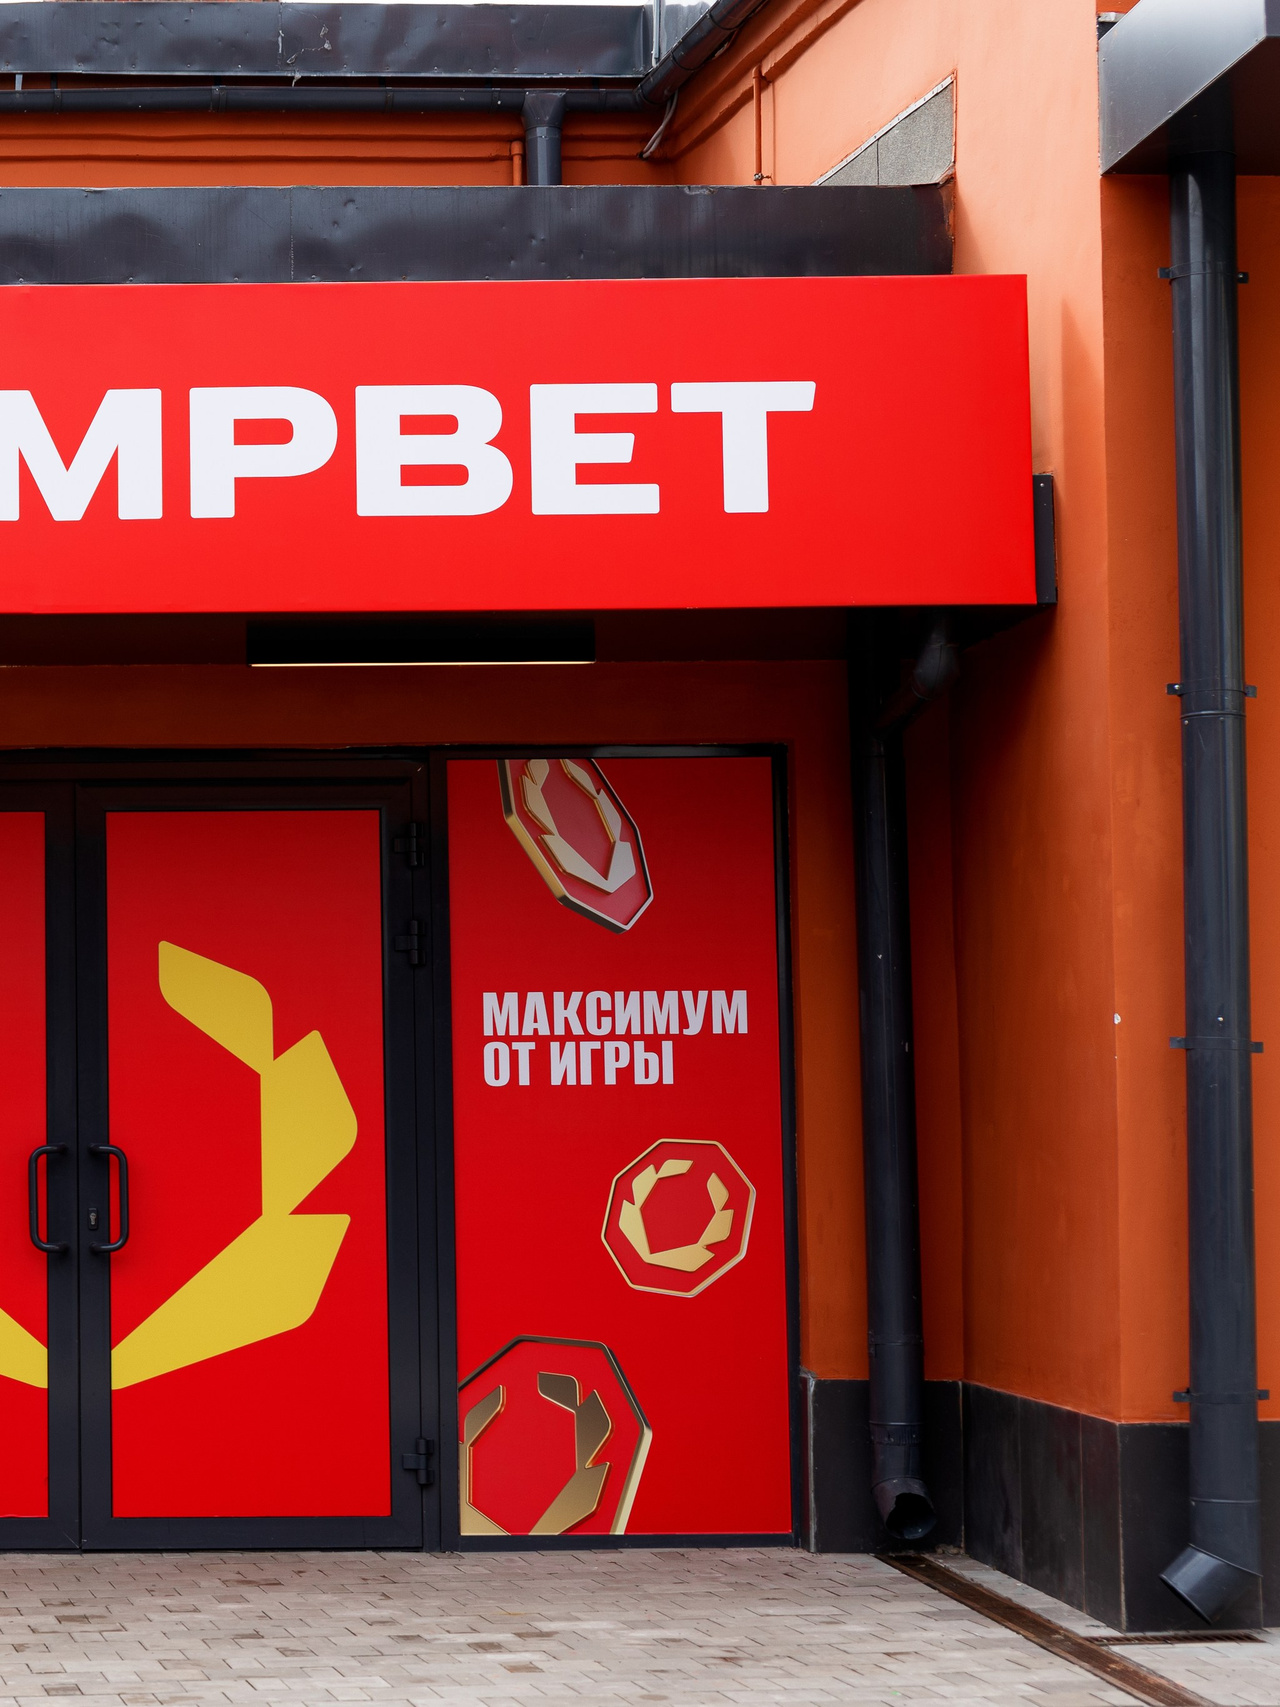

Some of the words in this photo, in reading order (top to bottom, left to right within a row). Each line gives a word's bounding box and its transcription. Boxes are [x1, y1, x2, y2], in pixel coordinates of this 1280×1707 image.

[482, 989, 748, 1036] МАКСИМУМ
[483, 1040, 536, 1088] ОТ
[549, 1040, 674, 1086] ИГРЫ
